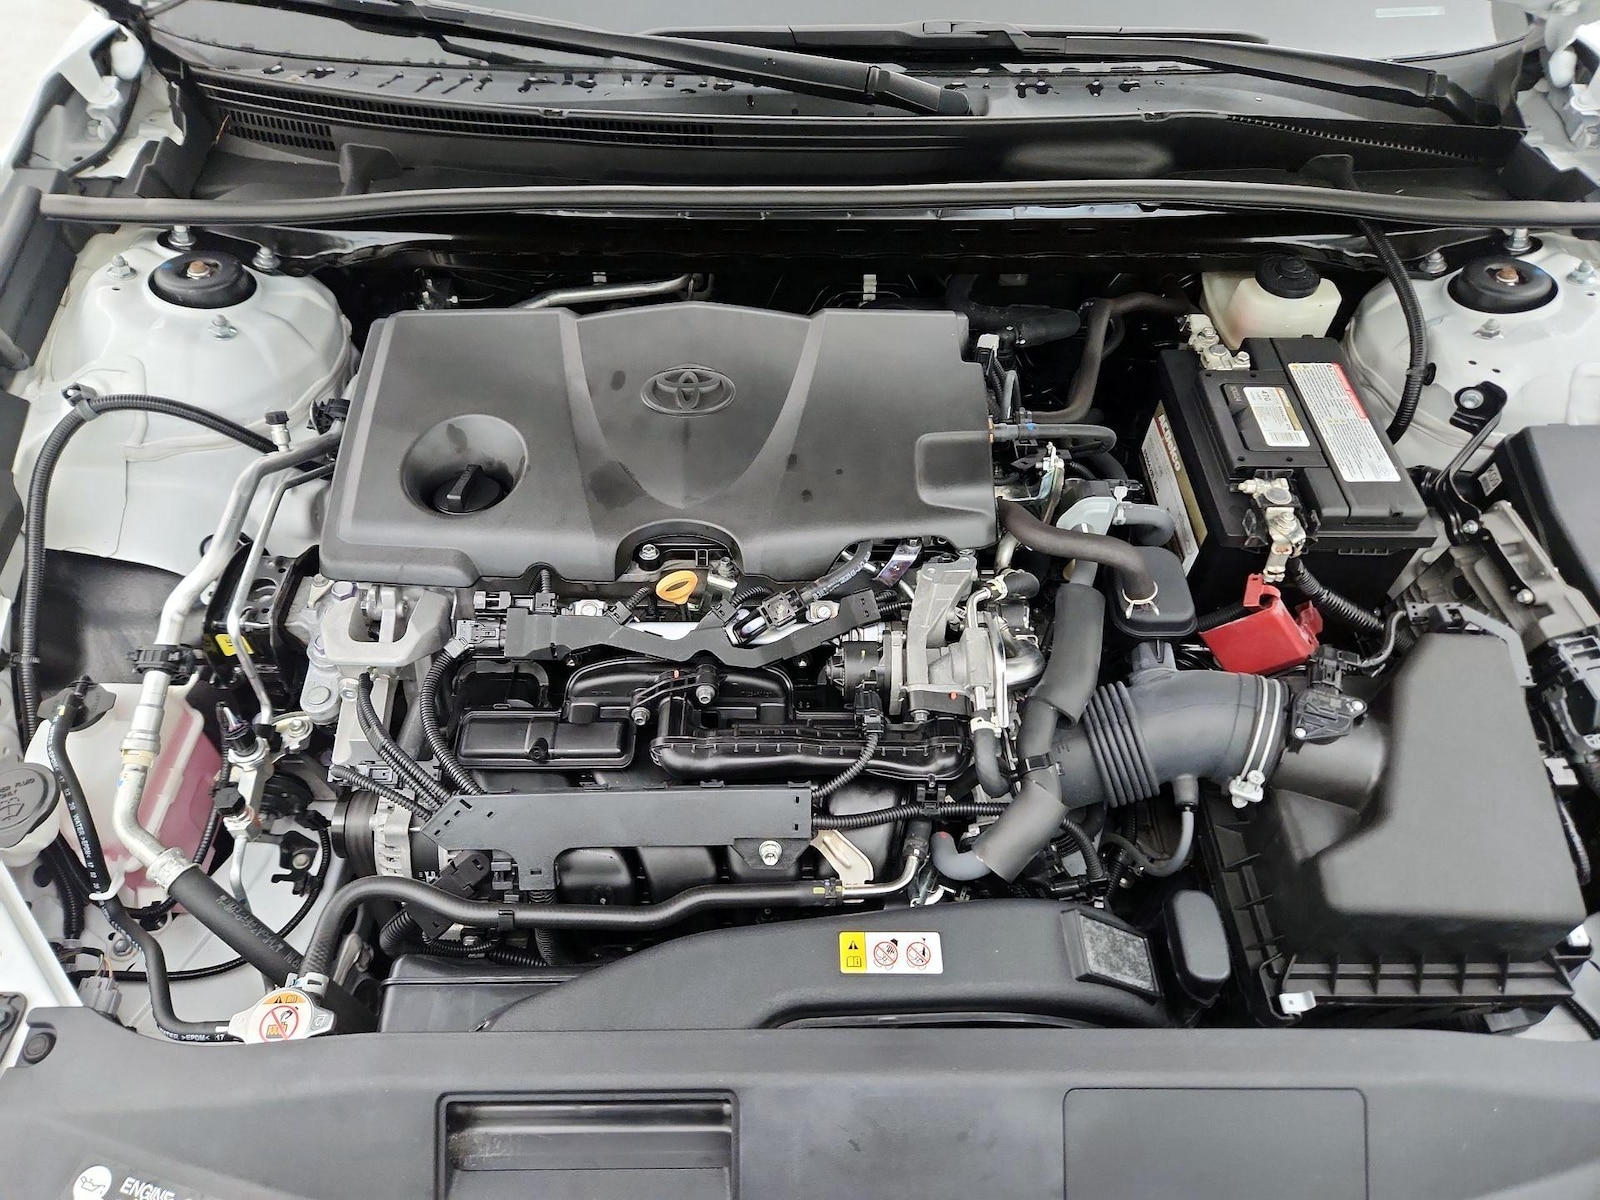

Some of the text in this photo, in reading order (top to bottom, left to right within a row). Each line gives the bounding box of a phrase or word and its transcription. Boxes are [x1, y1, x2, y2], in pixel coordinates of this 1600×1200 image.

[1158, 415, 1181, 472] ACDelco
[73, 814, 85, 837] WATER
[119, 1177, 175, 1200] ENGINE
